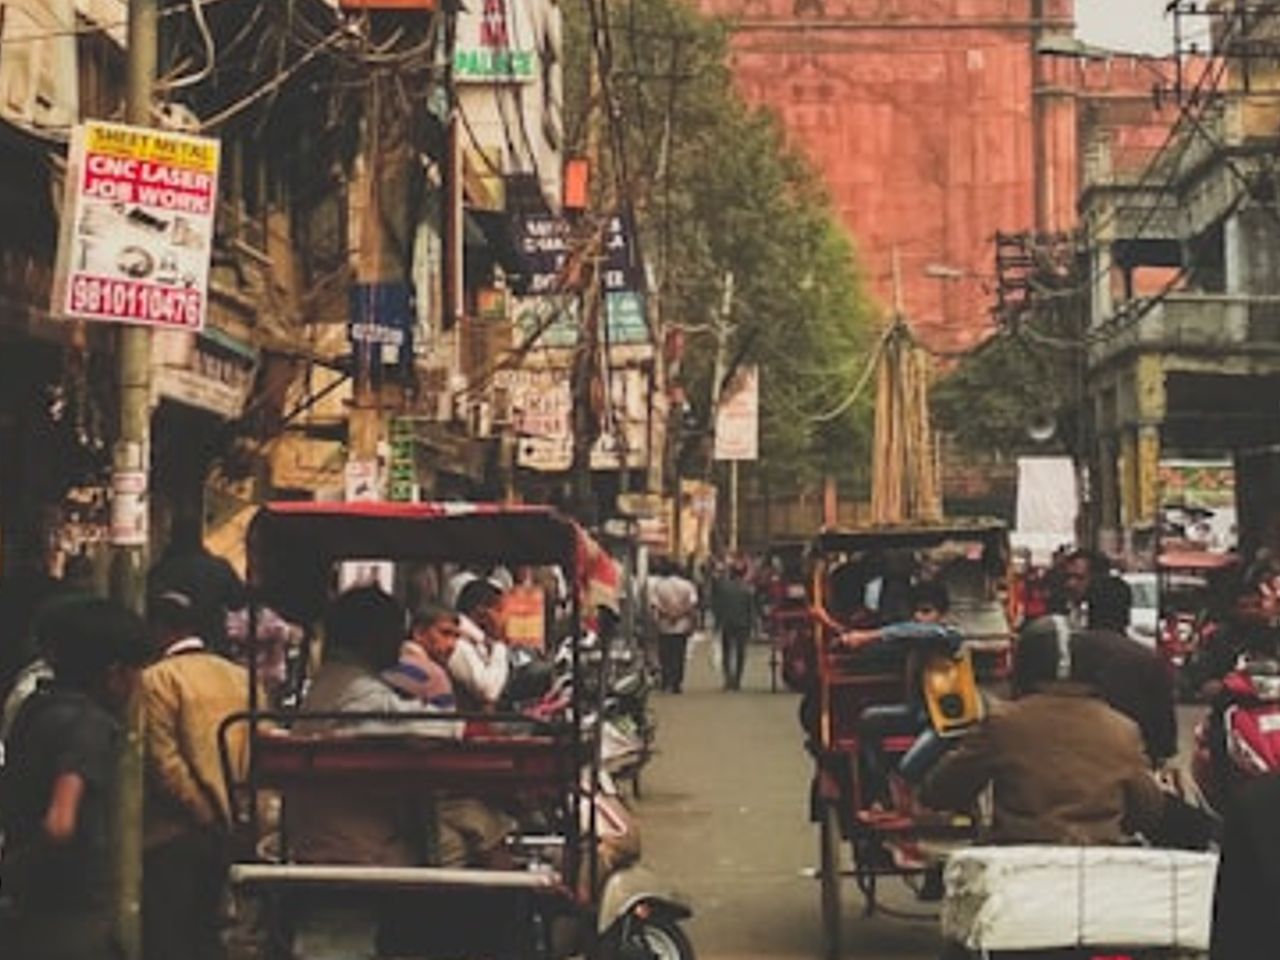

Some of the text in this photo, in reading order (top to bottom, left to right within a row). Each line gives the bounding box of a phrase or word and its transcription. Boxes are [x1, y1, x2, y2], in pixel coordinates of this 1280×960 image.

[89, 155, 210, 189] CNC LASER
[84, 176, 209, 213] JOB WORK
